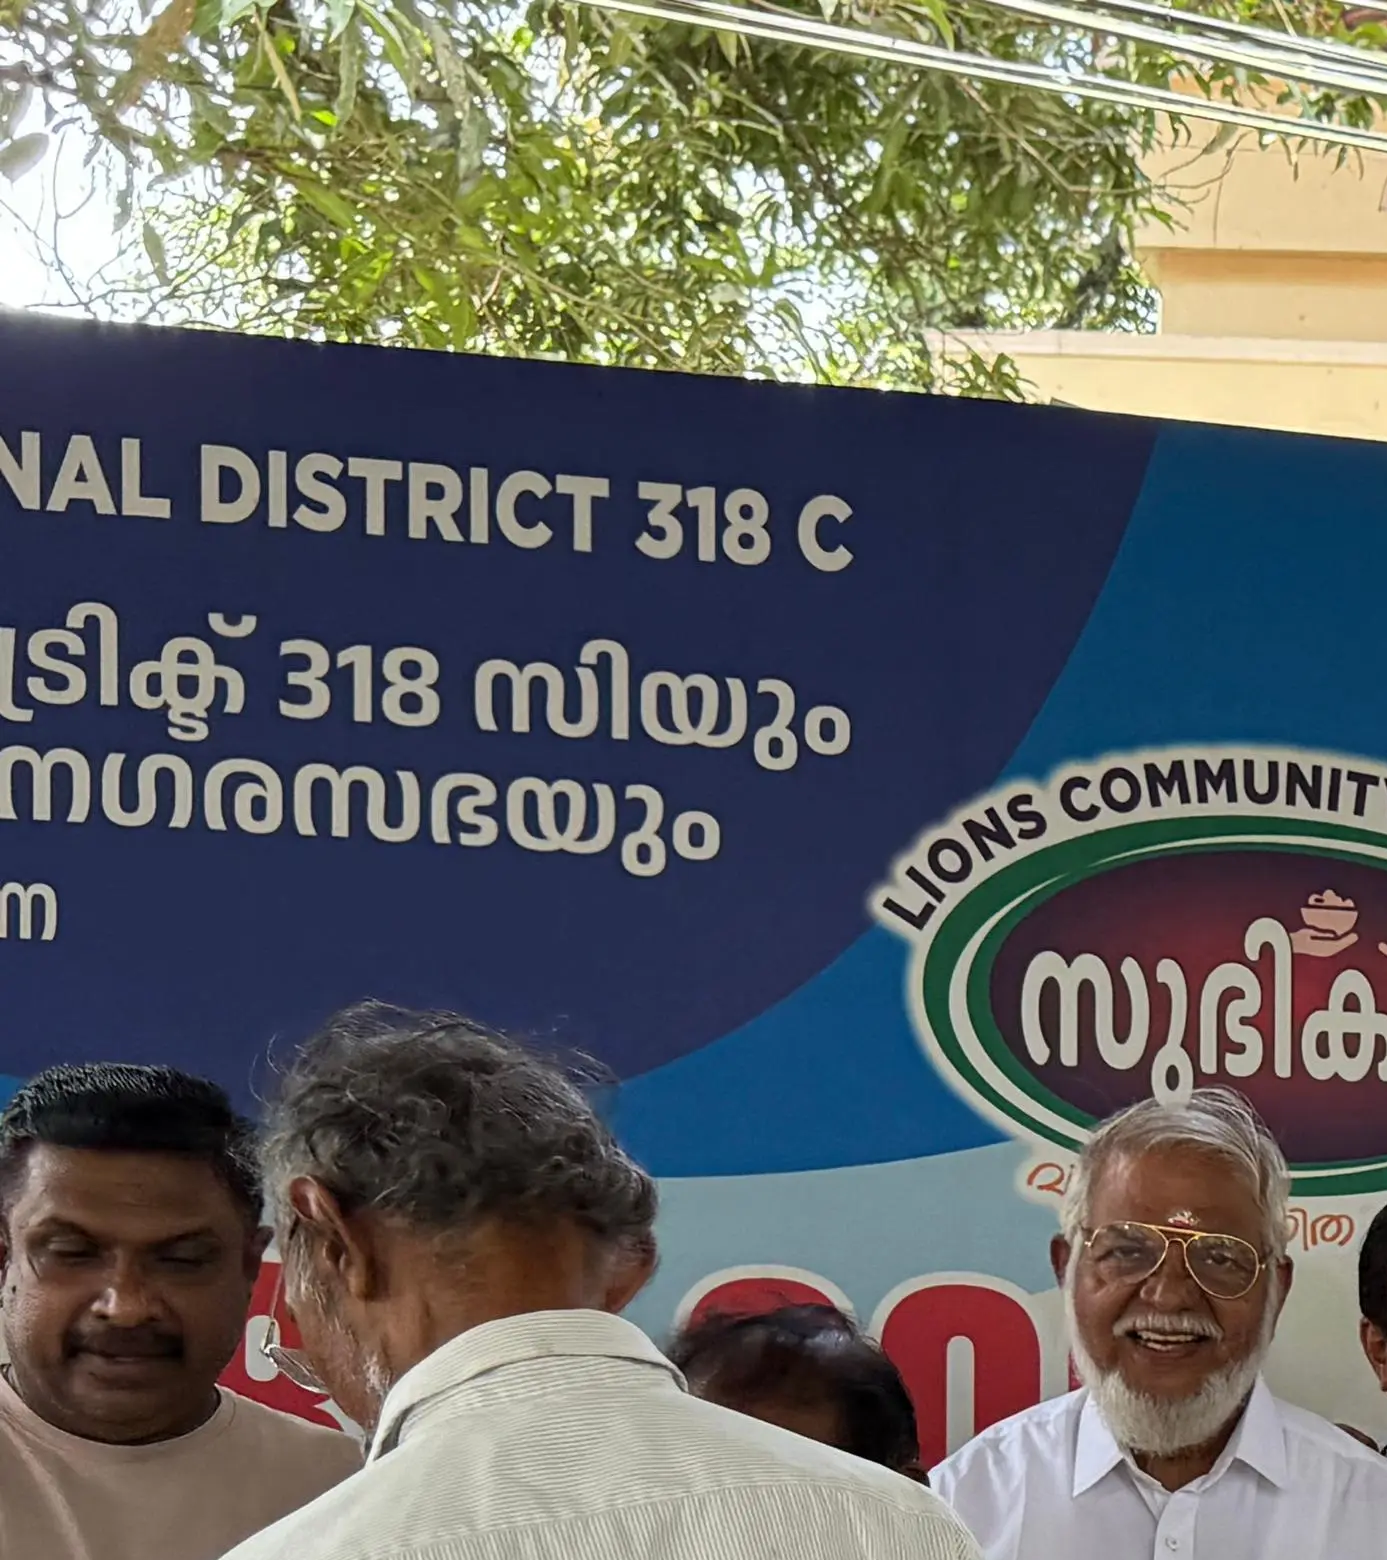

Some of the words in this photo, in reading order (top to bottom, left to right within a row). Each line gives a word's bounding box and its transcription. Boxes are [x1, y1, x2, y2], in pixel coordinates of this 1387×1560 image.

[0, 431, 171, 520] NAL
[200, 444, 609, 552] DISTRICT
[635, 481, 771, 566] 318
[798, 495, 854, 572] C
[278, 640, 440, 728] 318
[475, 640, 852, 770] സിയും
[883, 793, 1049, 931] LIONS
